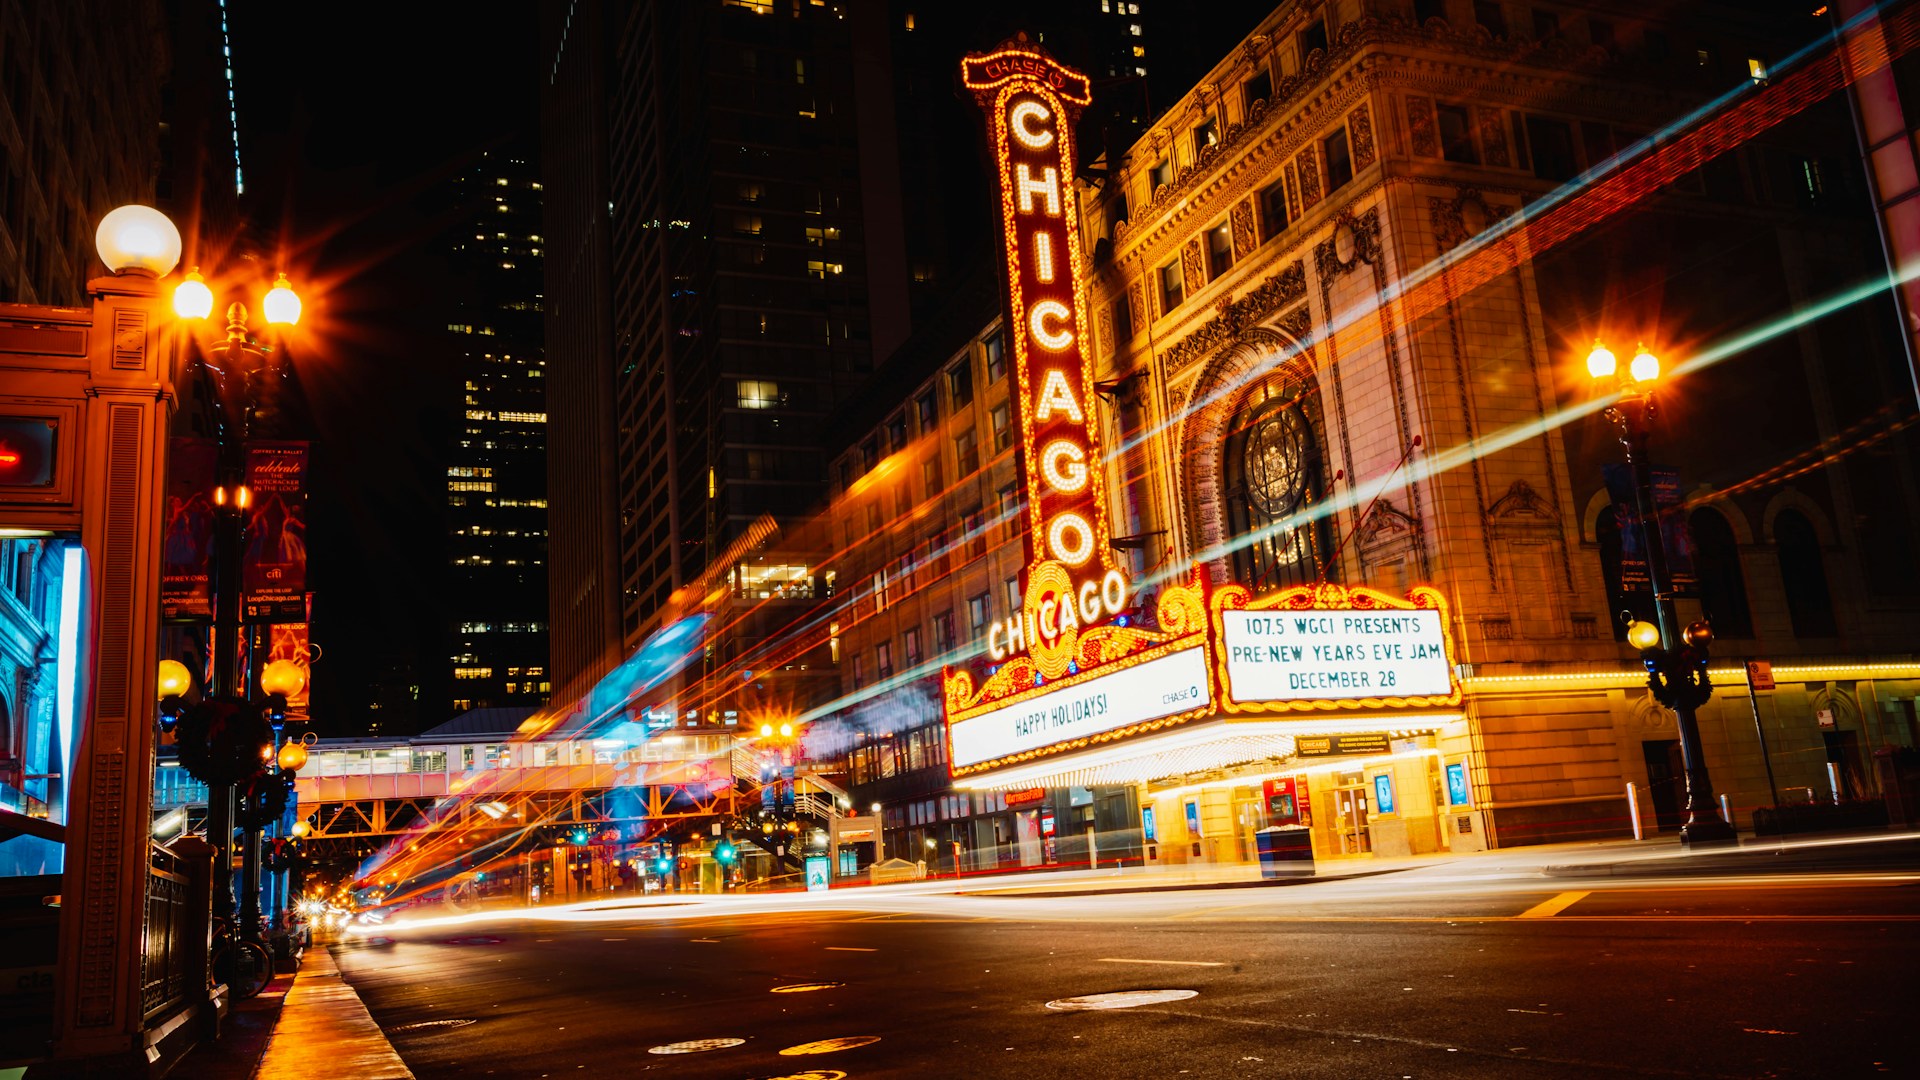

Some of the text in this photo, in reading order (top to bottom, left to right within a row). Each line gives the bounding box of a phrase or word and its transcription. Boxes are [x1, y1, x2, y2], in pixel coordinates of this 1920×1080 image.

[986, 59, 1046, 78] CHASE
[1011, 101, 1093, 565] CHICAGO
[254, 460, 301, 473] celebrate
[266, 568, 282, 579] citi
[247, 595, 301, 603] LoopChicago.com
[989, 570, 1125, 660] CHICAGO
[1245, 617, 1421, 636] 107.5 WGCI PRESENTS
[1232, 643, 1441, 663] PRE-NEW YEARS EVE JAM
[1289, 670, 1397, 690] DECEMBER 28
[1162, 689, 1189, 705] CHASE
[1015, 693, 1108, 737] HAPPY HOLIDAYS!
[17, 971, 52, 989] cta
